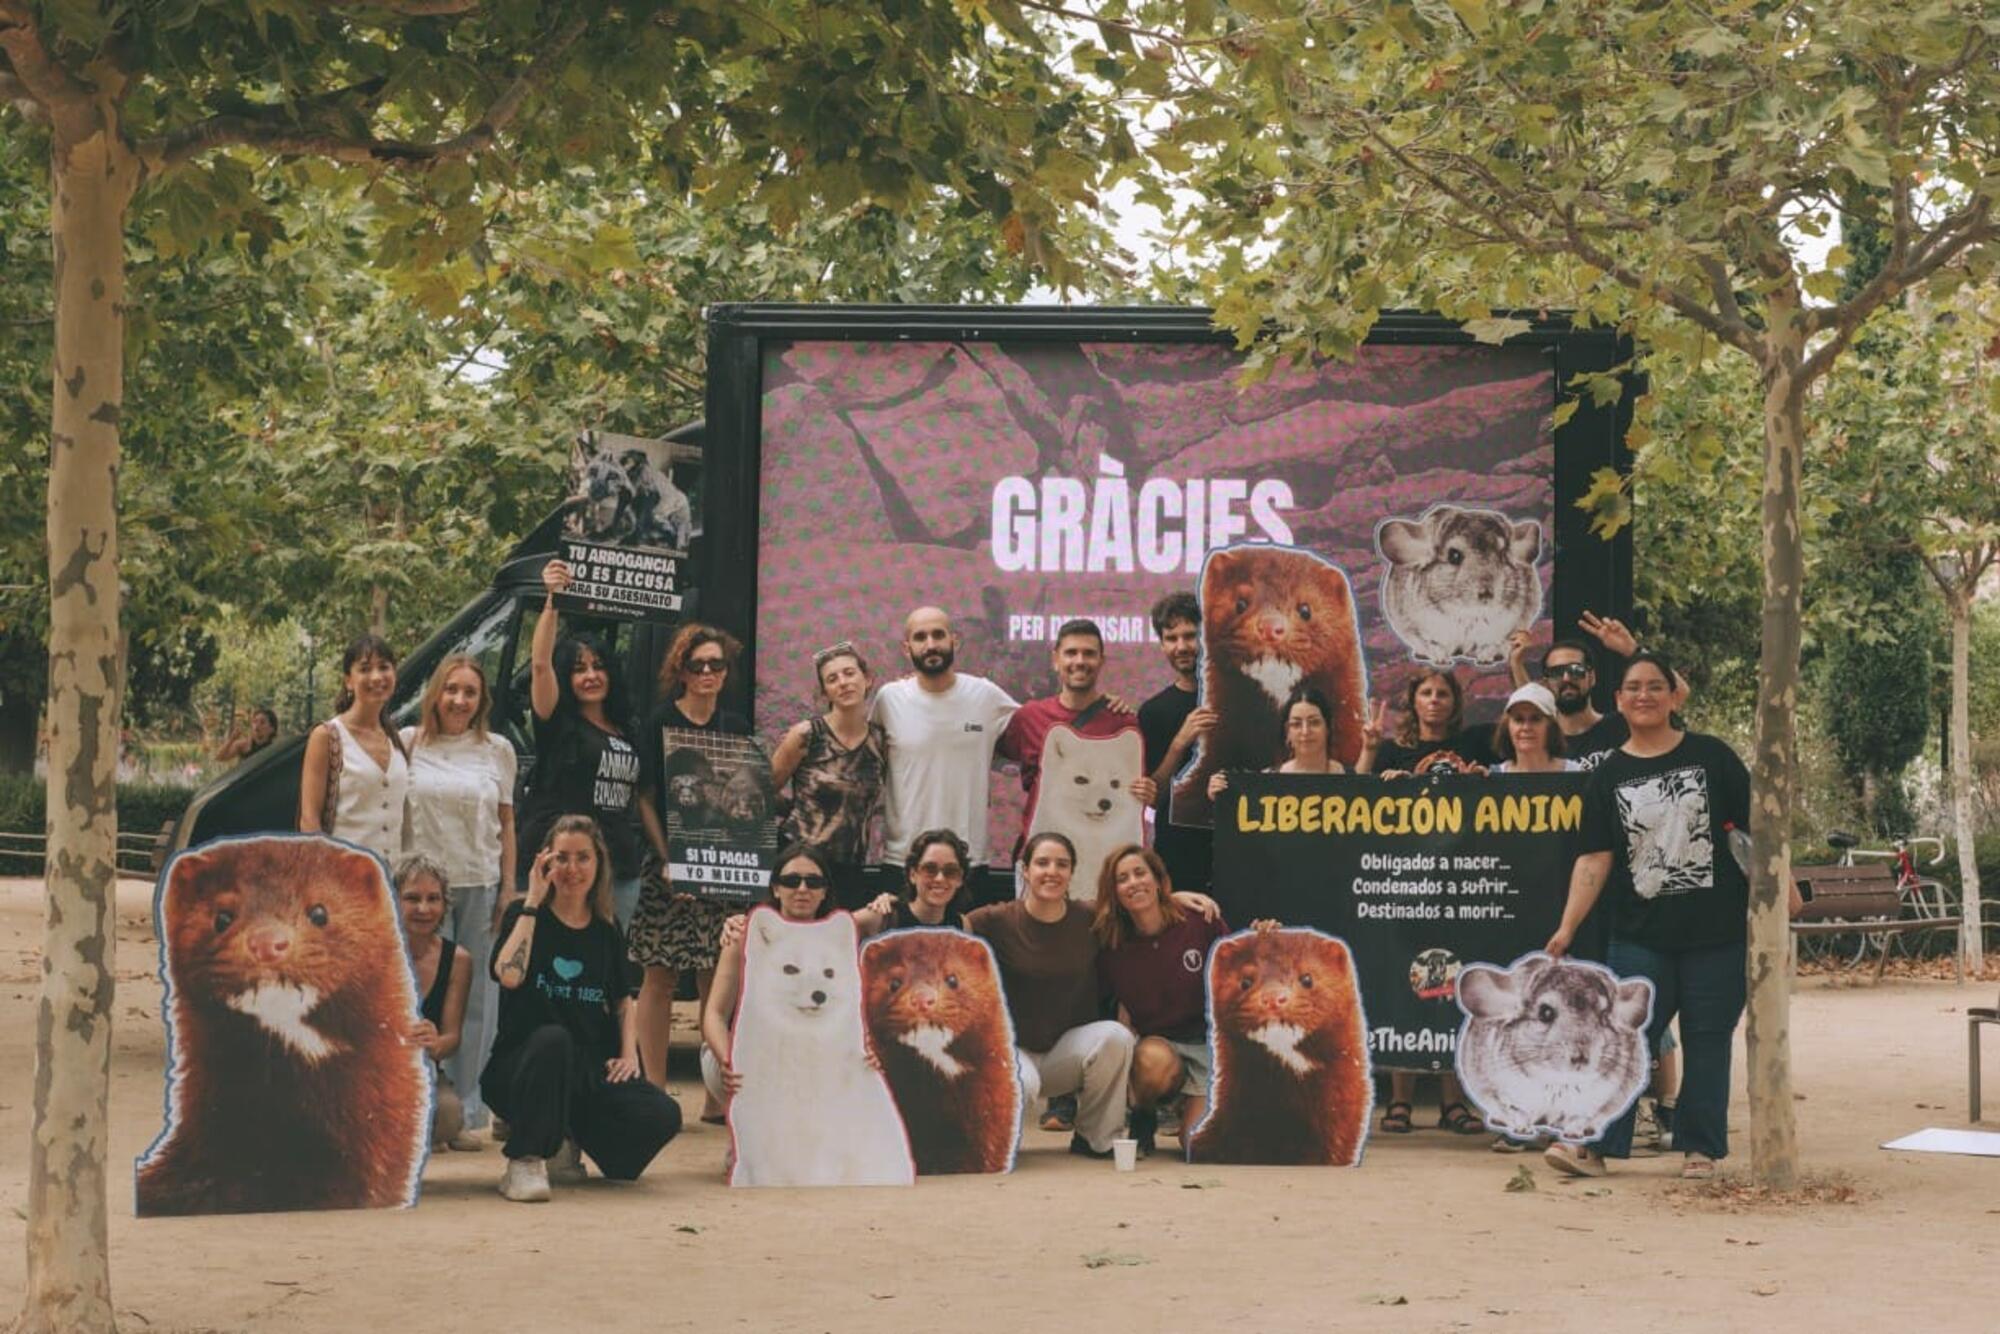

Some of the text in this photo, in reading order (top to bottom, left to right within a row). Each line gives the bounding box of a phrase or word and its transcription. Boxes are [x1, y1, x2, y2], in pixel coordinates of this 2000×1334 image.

[992, 453, 1294, 573] GRÀCIES
[569, 545, 676, 574] TU ARROGANCIA
[568, 563, 674, 591] NO ES EXCUSA
[595, 586, 609, 597] SU
[612, 588, 672, 606] ASESINATO
[1009, 615, 1044, 641] PER
[1237, 788, 1462, 835] LIBERACIÓN
[686, 847, 698, 863] SI
[719, 851, 758, 867] PAGAS
[1361, 853, 1435, 876] Obligados
[1439, 857, 1449, 870] a
[687, 866, 760, 883] YO MUERO
[1352, 877, 1443, 895] Condenados
[1447, 882, 1457, 894] a
[1358, 902, 1440, 919] Destinados
[1444, 906, 1455, 919] a
